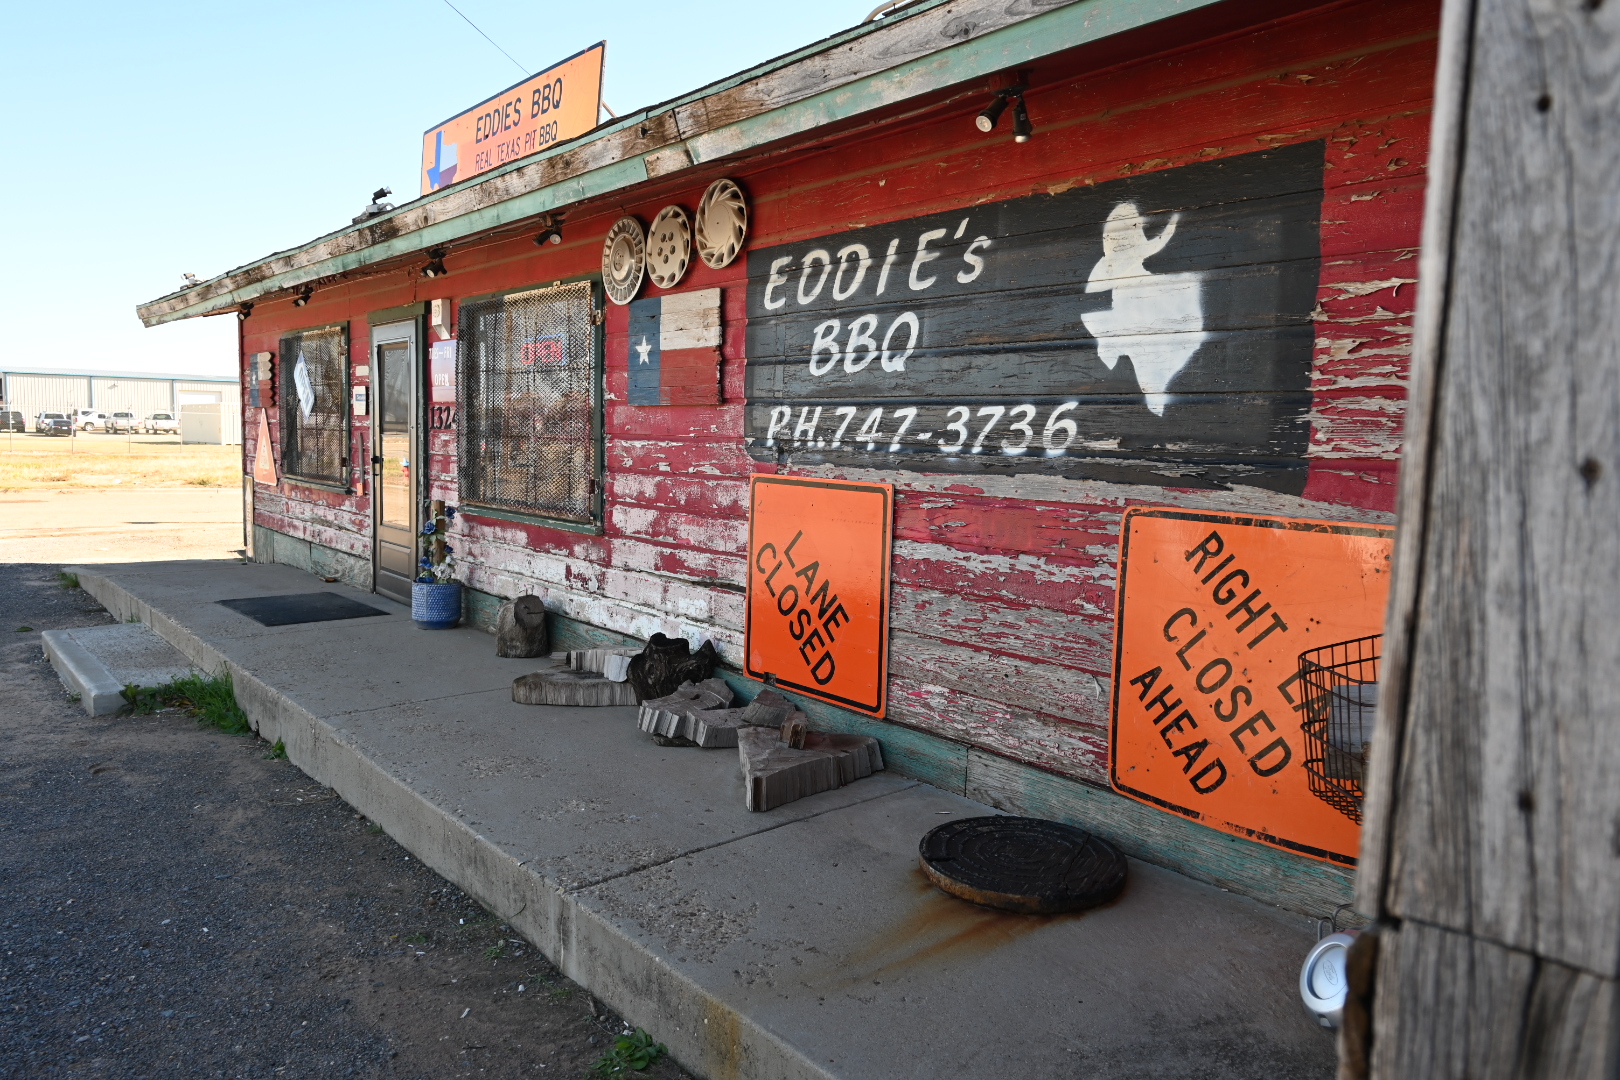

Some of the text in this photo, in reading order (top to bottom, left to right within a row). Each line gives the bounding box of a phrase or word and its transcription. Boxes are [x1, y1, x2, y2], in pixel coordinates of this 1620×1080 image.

[474, 119, 558, 173] REAL TEXAS PIT BBQ
[476, 78, 562, 144] EDDIES BBQ
[434, 373, 450, 387] OPEN
[808, 311, 920, 377] BBQ
[755, 542, 837, 686] CLOSED
[783, 529, 851, 643] LANE
[1184, 531, 1289, 650] RIGHT
[1129, 665, 1228, 795] AHEAD
[1162, 607, 1292, 778] CLOSED
